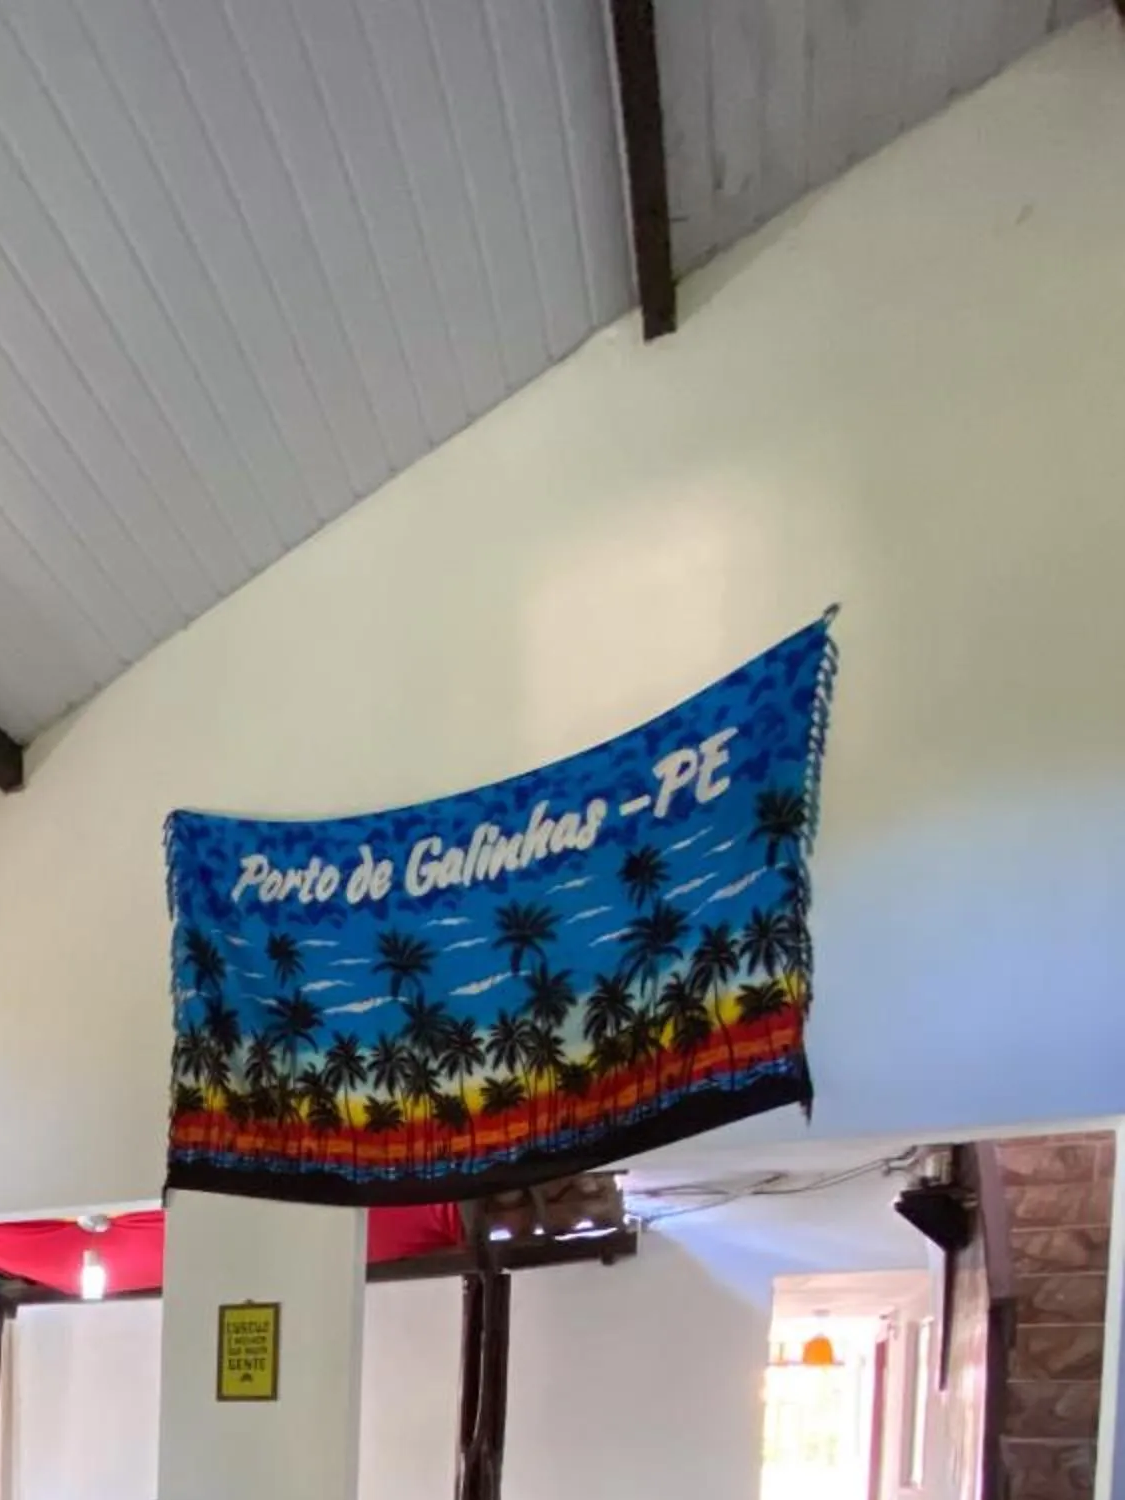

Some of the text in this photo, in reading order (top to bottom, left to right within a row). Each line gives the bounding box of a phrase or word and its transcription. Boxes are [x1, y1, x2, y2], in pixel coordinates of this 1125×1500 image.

[232, 854, 340, 903] Porto
[346, 845, 393, 904] de
[405, 799, 607, 897] Galinhas
